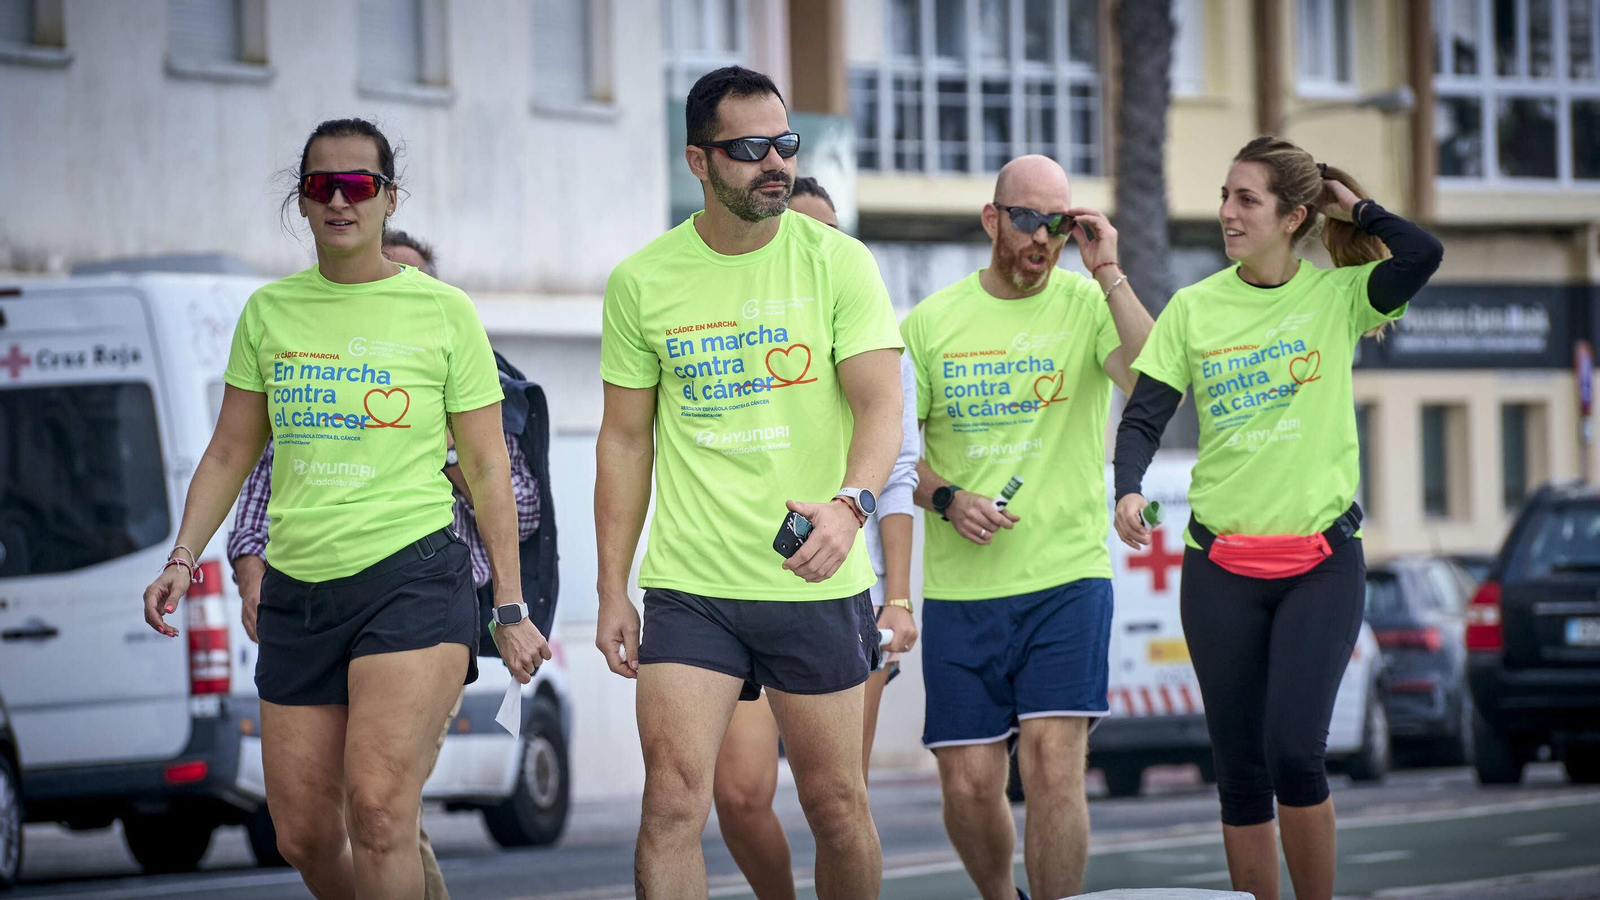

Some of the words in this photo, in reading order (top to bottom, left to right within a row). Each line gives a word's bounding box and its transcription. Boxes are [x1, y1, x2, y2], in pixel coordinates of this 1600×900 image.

[665, 328, 673, 336] IX
[672, 325, 694, 335] CÁDIZ
[695, 323, 705, 331] EN
[706, 320, 737, 330] MARCHA
[665, 337, 694, 359] En
[701, 324, 788, 353] marcha
[36, 347, 86, 370] Cruz
[92, 344, 141, 371] Roja
[280, 350, 298, 359] CÁDIZ
[309, 352, 340, 360] MARCHA
[673, 355, 745, 379] contra
[943, 361, 967, 379] En
[973, 355, 1055, 376] marcha
[1202, 360, 1222, 379] En
[1228, 339, 1306, 371] marcha
[273, 361, 294, 382] En
[300, 363, 391, 385] marcha
[1207, 370, 1270, 398] contra
[273, 383, 337, 404] contra
[682, 380, 698, 401] el
[702, 374, 775, 401] cáncer
[944, 379, 1011, 399] contra
[1210, 399, 1230, 417] el
[1231, 381, 1299, 411] cáncer
[702, 404, 728, 412] ESPAÑOLA
[728, 403, 746, 411] CONTRA
[750, 399, 770, 407] CÁNCER
[947, 401, 964, 418] el
[968, 399, 1041, 418] cáncer
[274, 407, 288, 428] el
[291, 406, 371, 430] cáncer
[340, 434, 362, 442] CÁNCER
[721, 424, 790, 445] HYUNDAI
[310, 461, 377, 478] HYUNDAI
